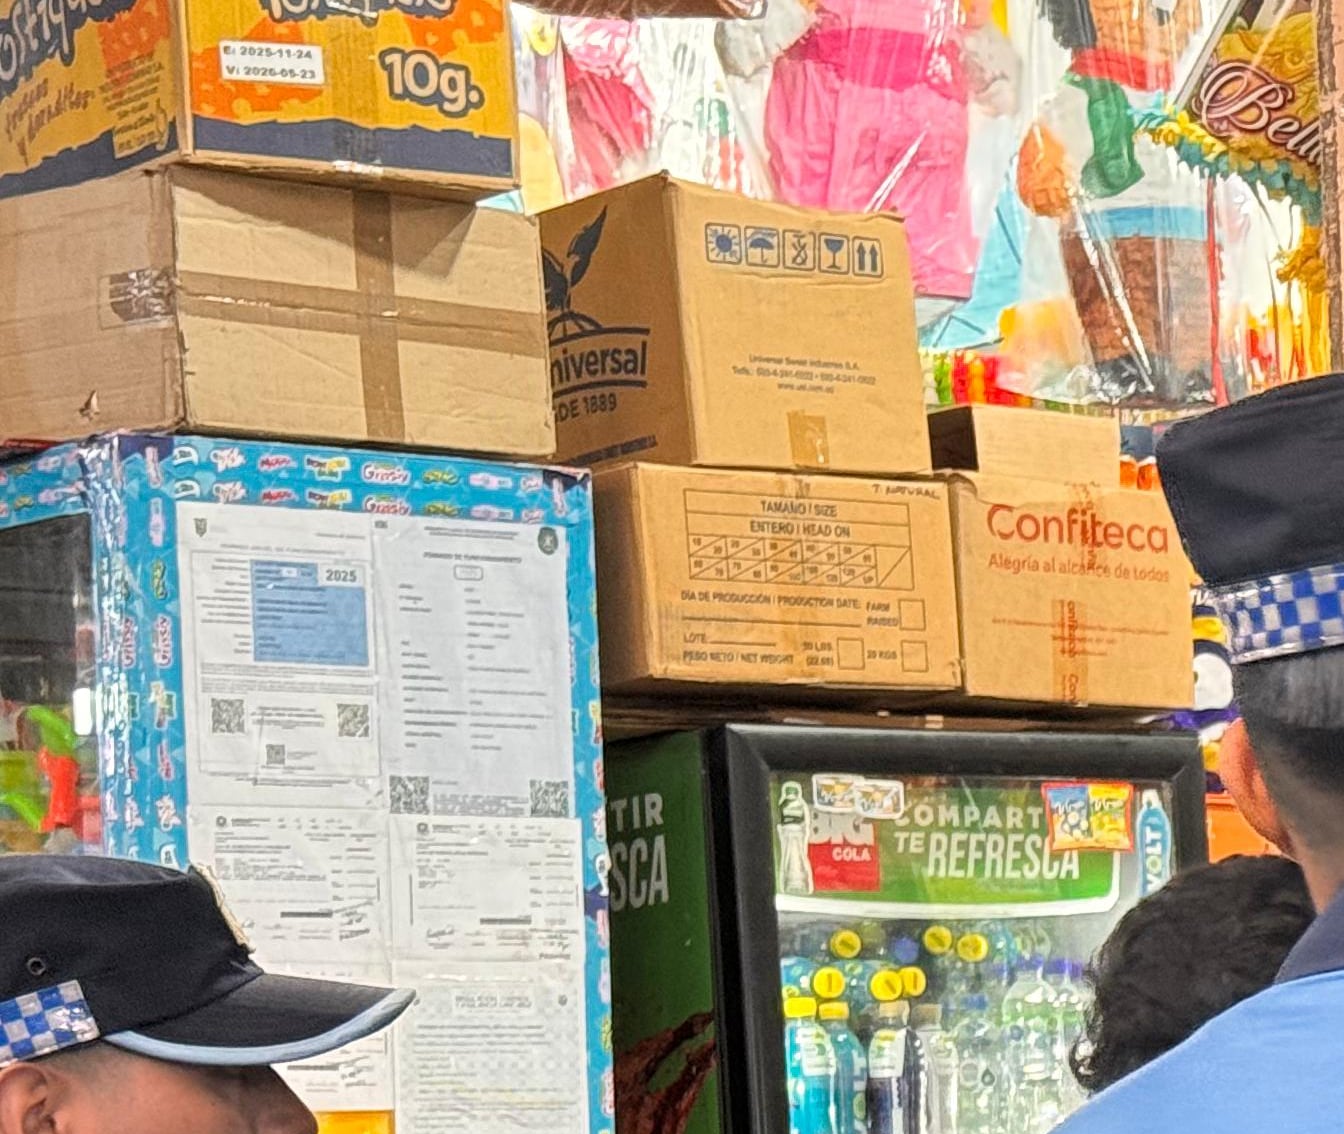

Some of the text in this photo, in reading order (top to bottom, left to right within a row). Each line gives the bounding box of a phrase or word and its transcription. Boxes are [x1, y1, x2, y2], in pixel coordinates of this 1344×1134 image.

[240, 46, 312, 60] 2025-11-24
[381, 48, 484, 115] 10g.
[550, 341, 648, 387] niversal
[814, 502, 837, 518] SIZE
[750, 520, 794, 536] ENTERO
[803, 523, 832, 538] HEAD
[834, 525, 850, 539] ON
[986, 503, 1170, 555] Confiteca
[326, 569, 357, 583] 2025
[988, 553, 1170, 583] Alegría al alcance de todos
[610, 793, 664, 832] TIR
[832, 847, 871, 862] COLA
[894, 831, 1080, 880] TE REFRESCA
[609, 835, 669, 912] SCA
